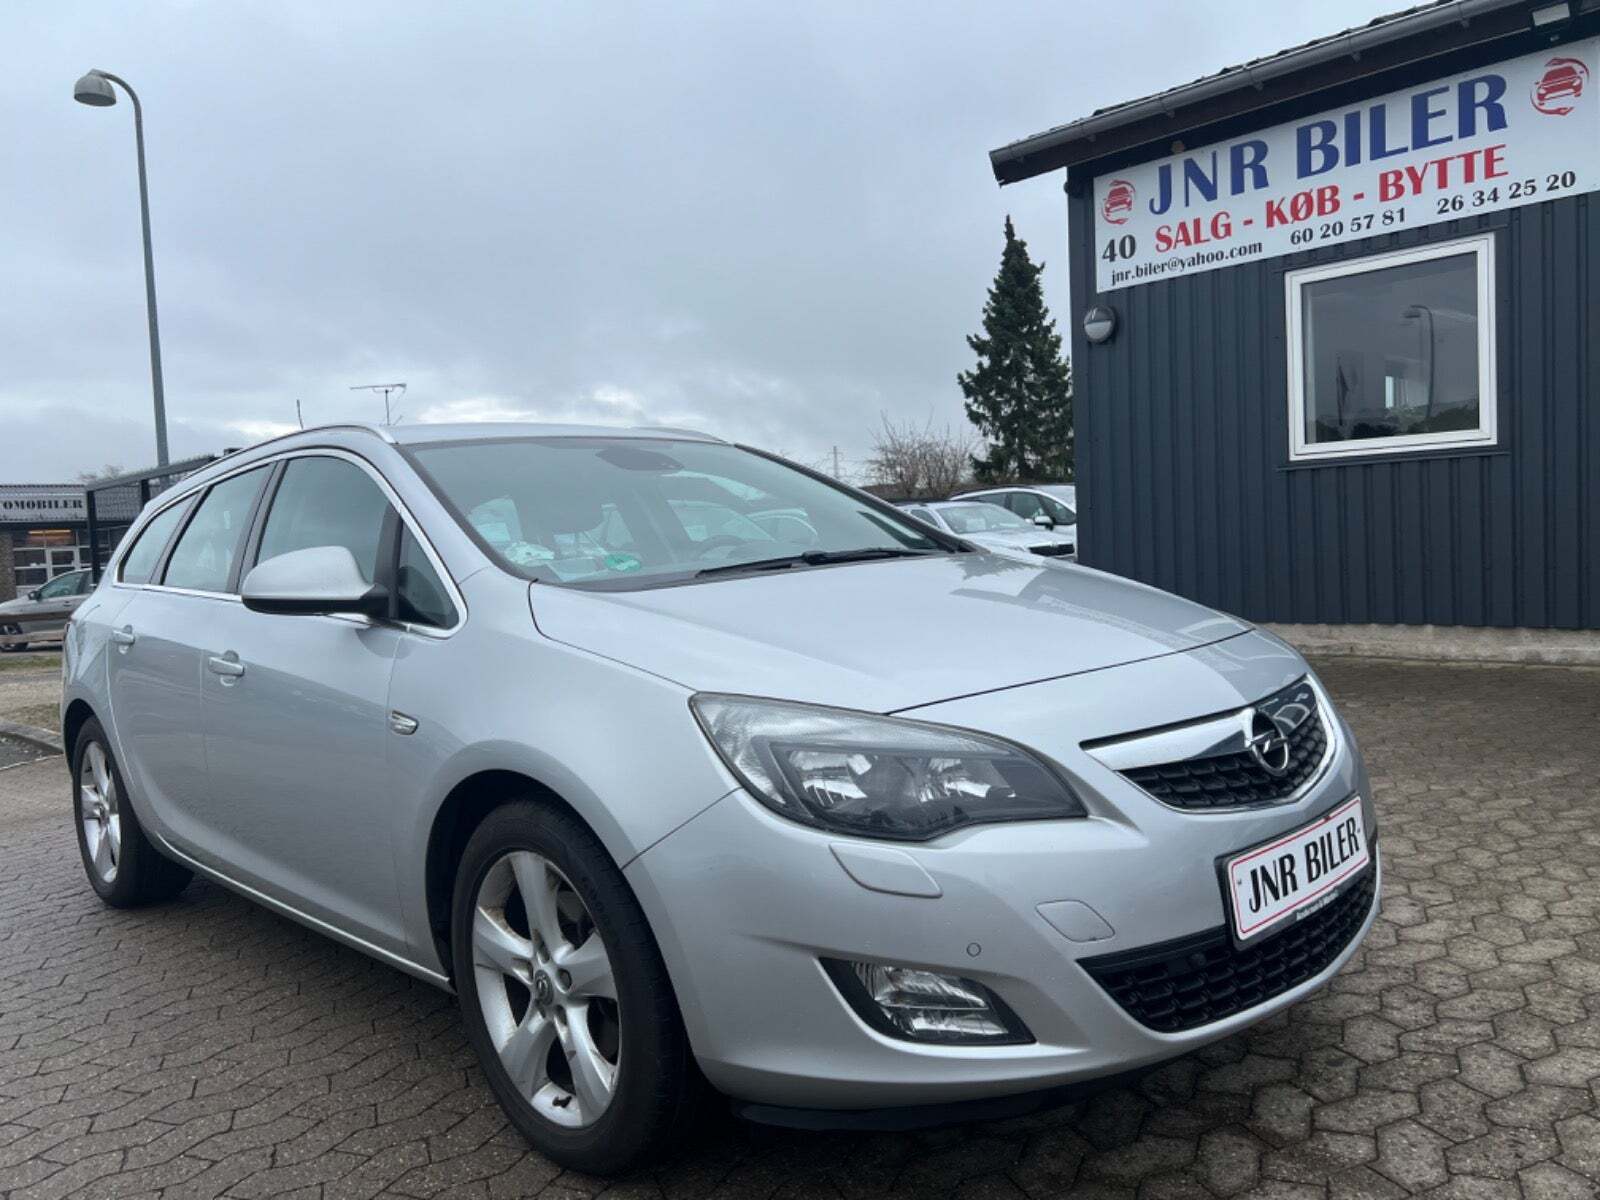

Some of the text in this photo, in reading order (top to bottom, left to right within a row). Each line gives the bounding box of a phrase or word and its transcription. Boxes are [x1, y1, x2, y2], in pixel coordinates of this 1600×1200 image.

[1149, 74, 1508, 216] JNR BILER
[1155, 211, 1233, 253] SALG
[1266, 184, 1341, 229] KØB
[1379, 144, 1509, 203] BYTTE
[1437, 170, 1576, 215] 26 34 25 20
[1102, 234, 1137, 263] 40
[1290, 206, 1406, 246] 60 20 57 81
[1111, 241, 1263, 285] jnr.biler@yahoo.com
[1248, 853, 1299, 914] JNR
[1304, 816, 1360, 884] BILER
